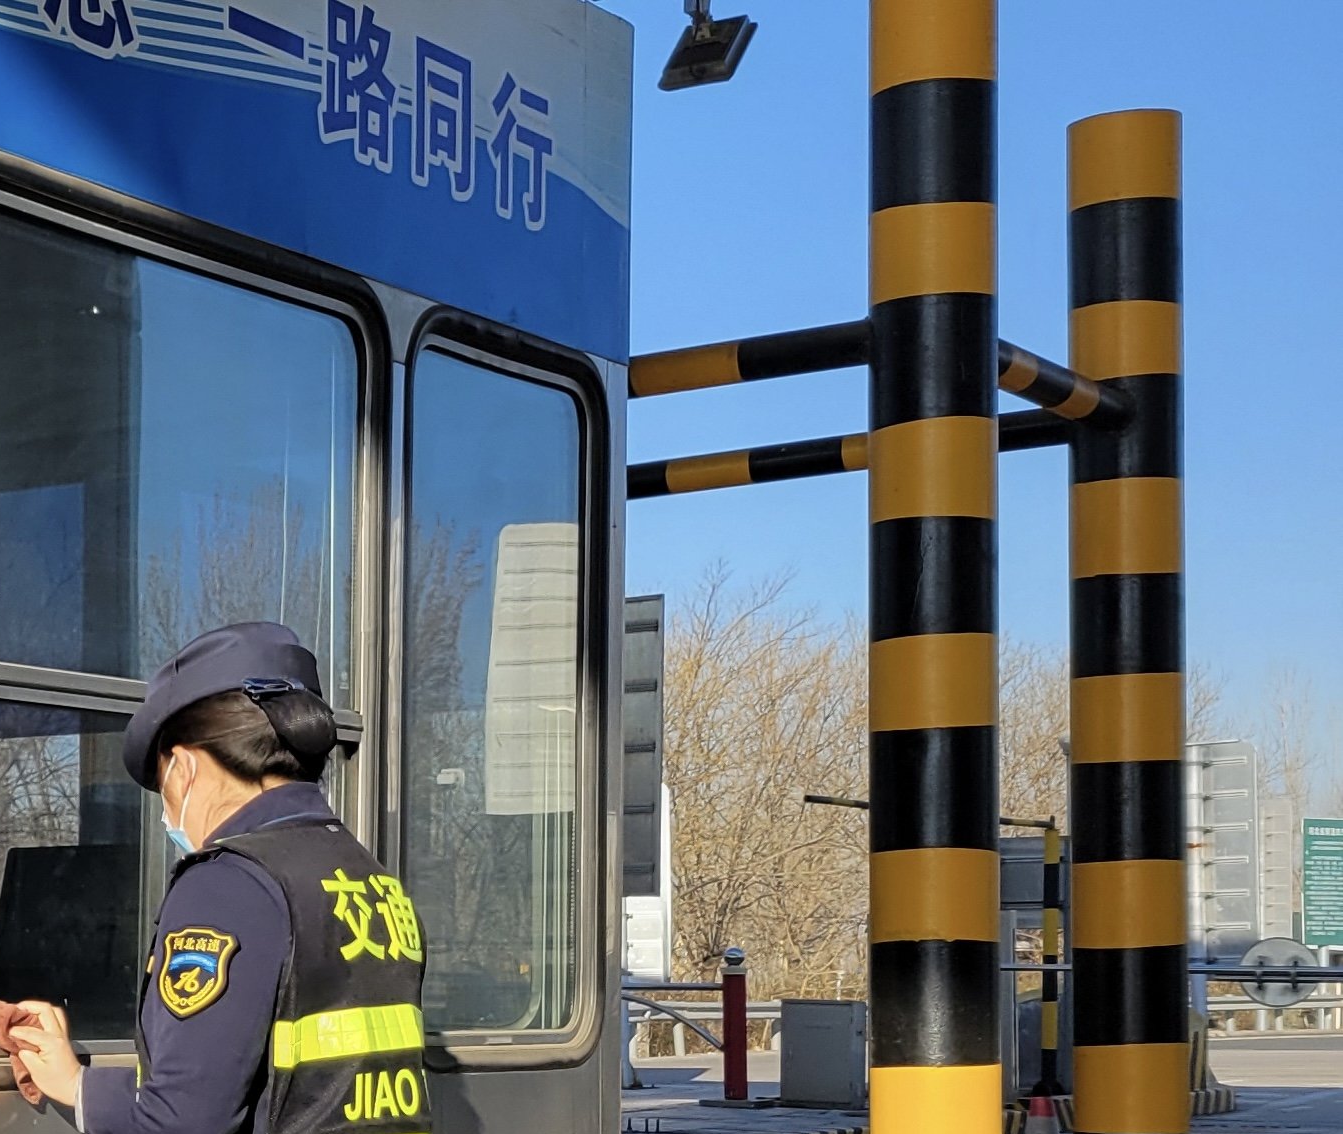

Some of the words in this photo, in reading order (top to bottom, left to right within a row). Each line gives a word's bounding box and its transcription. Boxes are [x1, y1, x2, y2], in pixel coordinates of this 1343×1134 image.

[228, 0, 553, 224] 一路同行
[173, 937, 221, 952] 河北高速
[321, 867, 422, 962] 交通
[344, 1068, 420, 1121] JIAO
